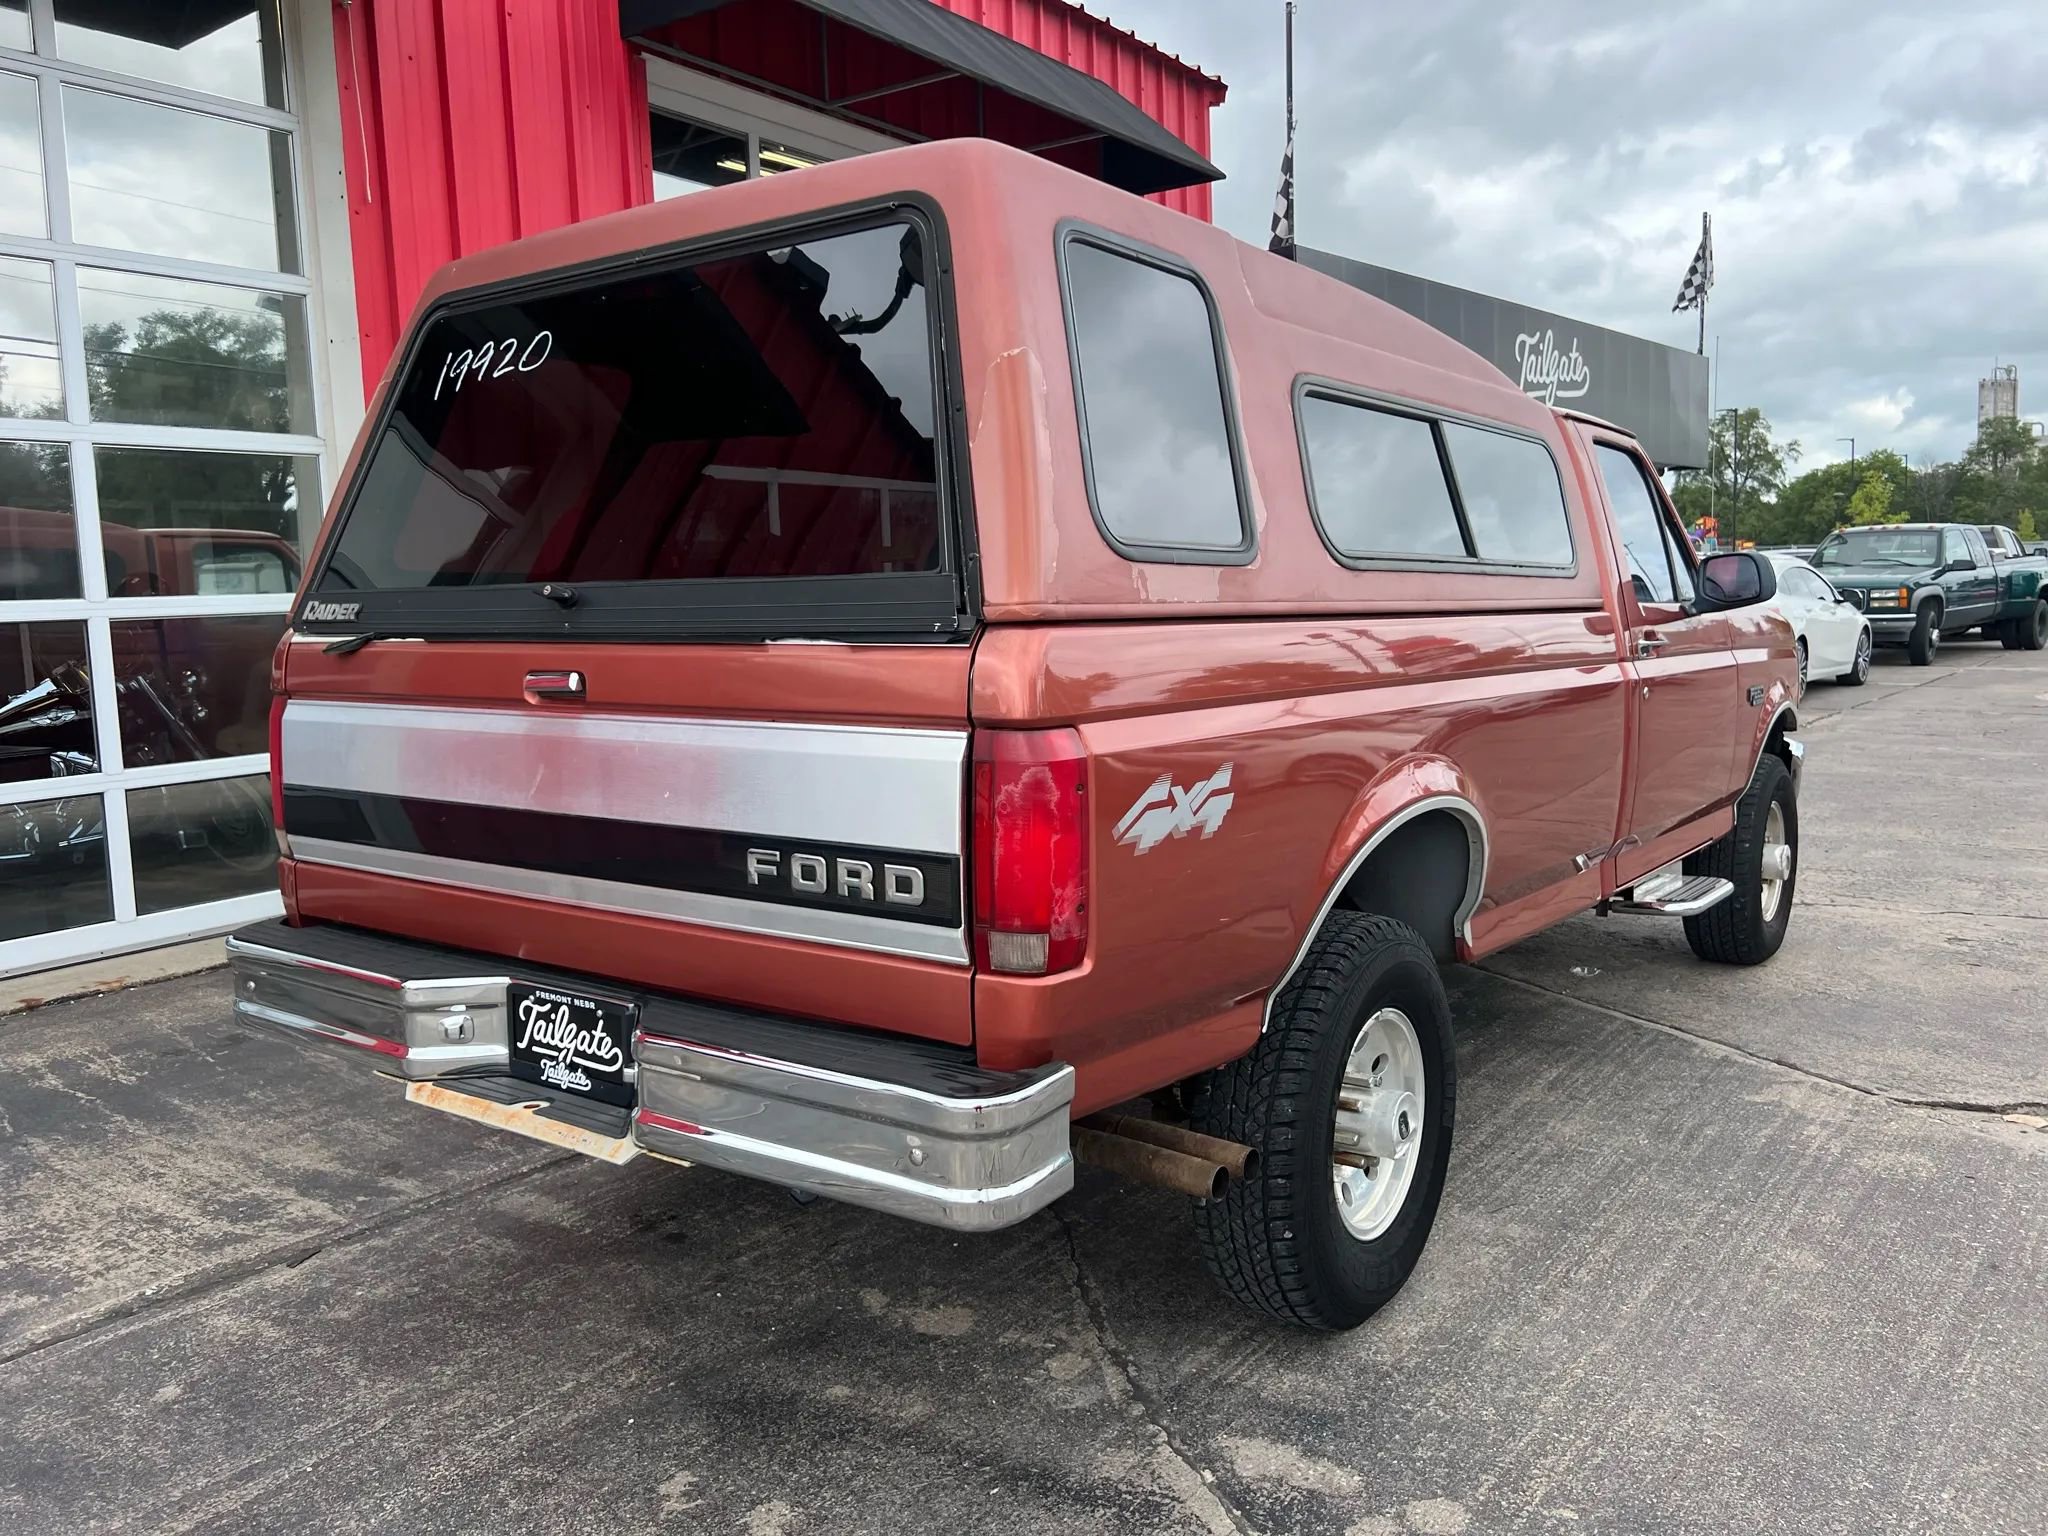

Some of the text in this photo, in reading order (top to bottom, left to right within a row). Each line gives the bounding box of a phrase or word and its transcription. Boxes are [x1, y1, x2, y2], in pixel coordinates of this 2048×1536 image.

[434, 330, 553, 401] 19920
[1515, 329, 1590, 407] Tailgate
[301, 600, 361, 621] RAIDER
[747, 848, 925, 907] FORD
[535, 990, 596, 1010] FREMONT NEBR
[516, 999, 624, 1073] Tailgate
[540, 1059, 592, 1092] Tailgate
